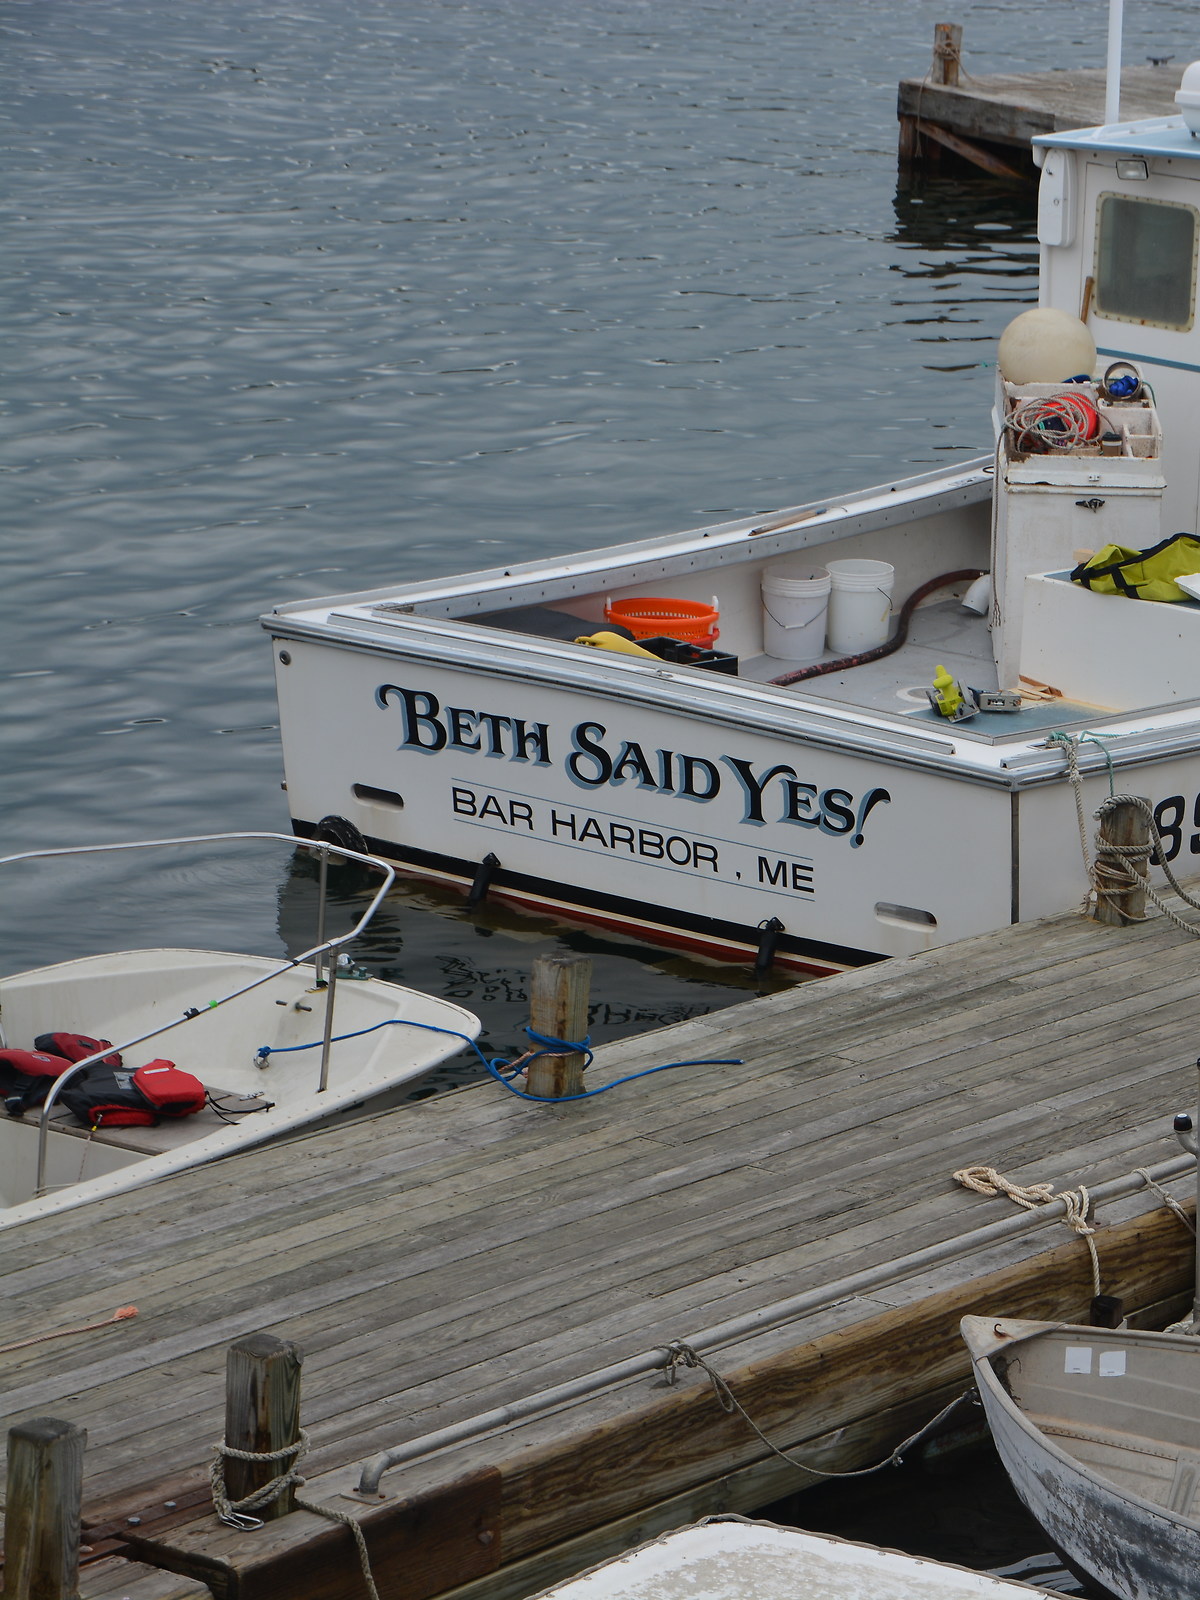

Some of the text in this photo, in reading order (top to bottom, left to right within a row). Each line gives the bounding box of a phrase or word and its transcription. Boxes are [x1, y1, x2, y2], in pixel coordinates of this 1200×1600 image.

[375, 684, 553, 767] BETH
[564, 721, 721, 804] SAID
[452, 786, 534, 831] BAR
[551, 809, 719, 873] HARBOR
[757, 855, 815, 894] ME
